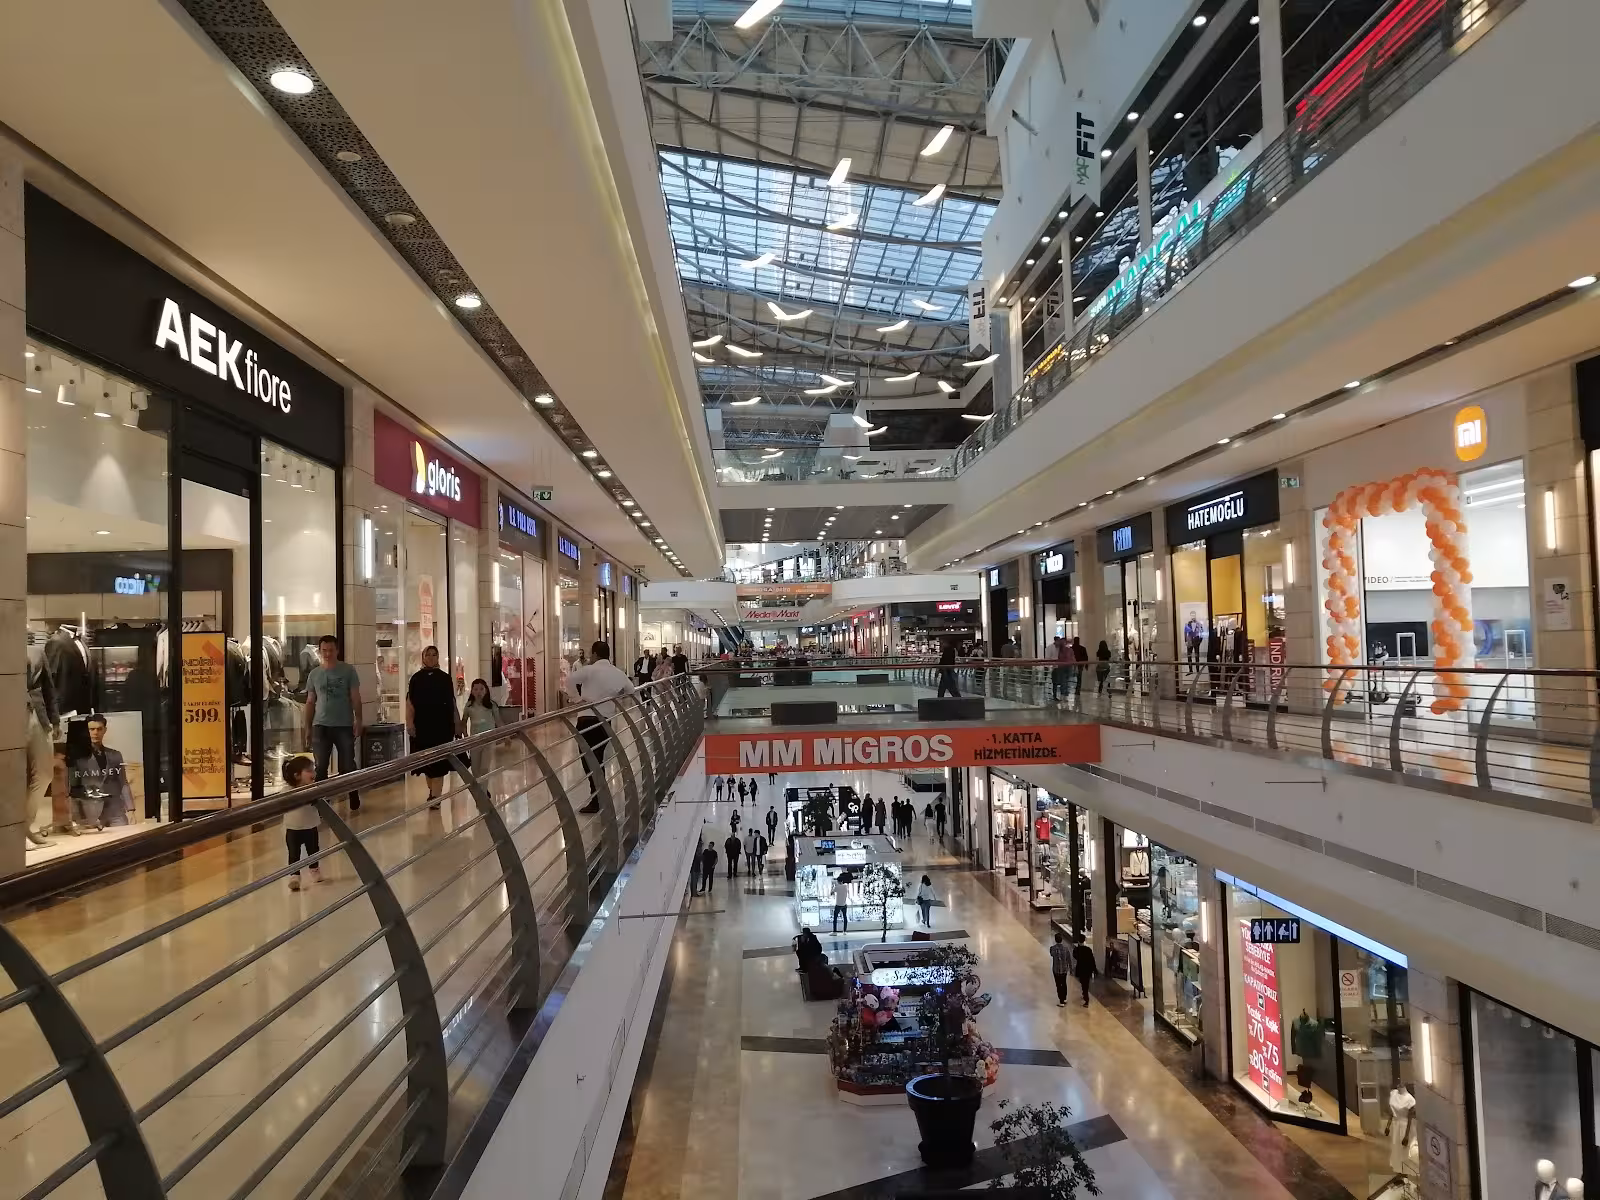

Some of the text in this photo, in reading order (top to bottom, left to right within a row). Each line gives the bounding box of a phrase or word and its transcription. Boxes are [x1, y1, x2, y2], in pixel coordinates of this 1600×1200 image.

[155, 297, 292, 414] AEK fiore
[428, 459, 461, 502] gloris
[1187, 496, 1244, 530] HATEMOĞLU
[739, 738, 803, 768] MM
[1003, 732, 1043, 744] KATTA
[74, 767, 122, 778] RAMSEY
